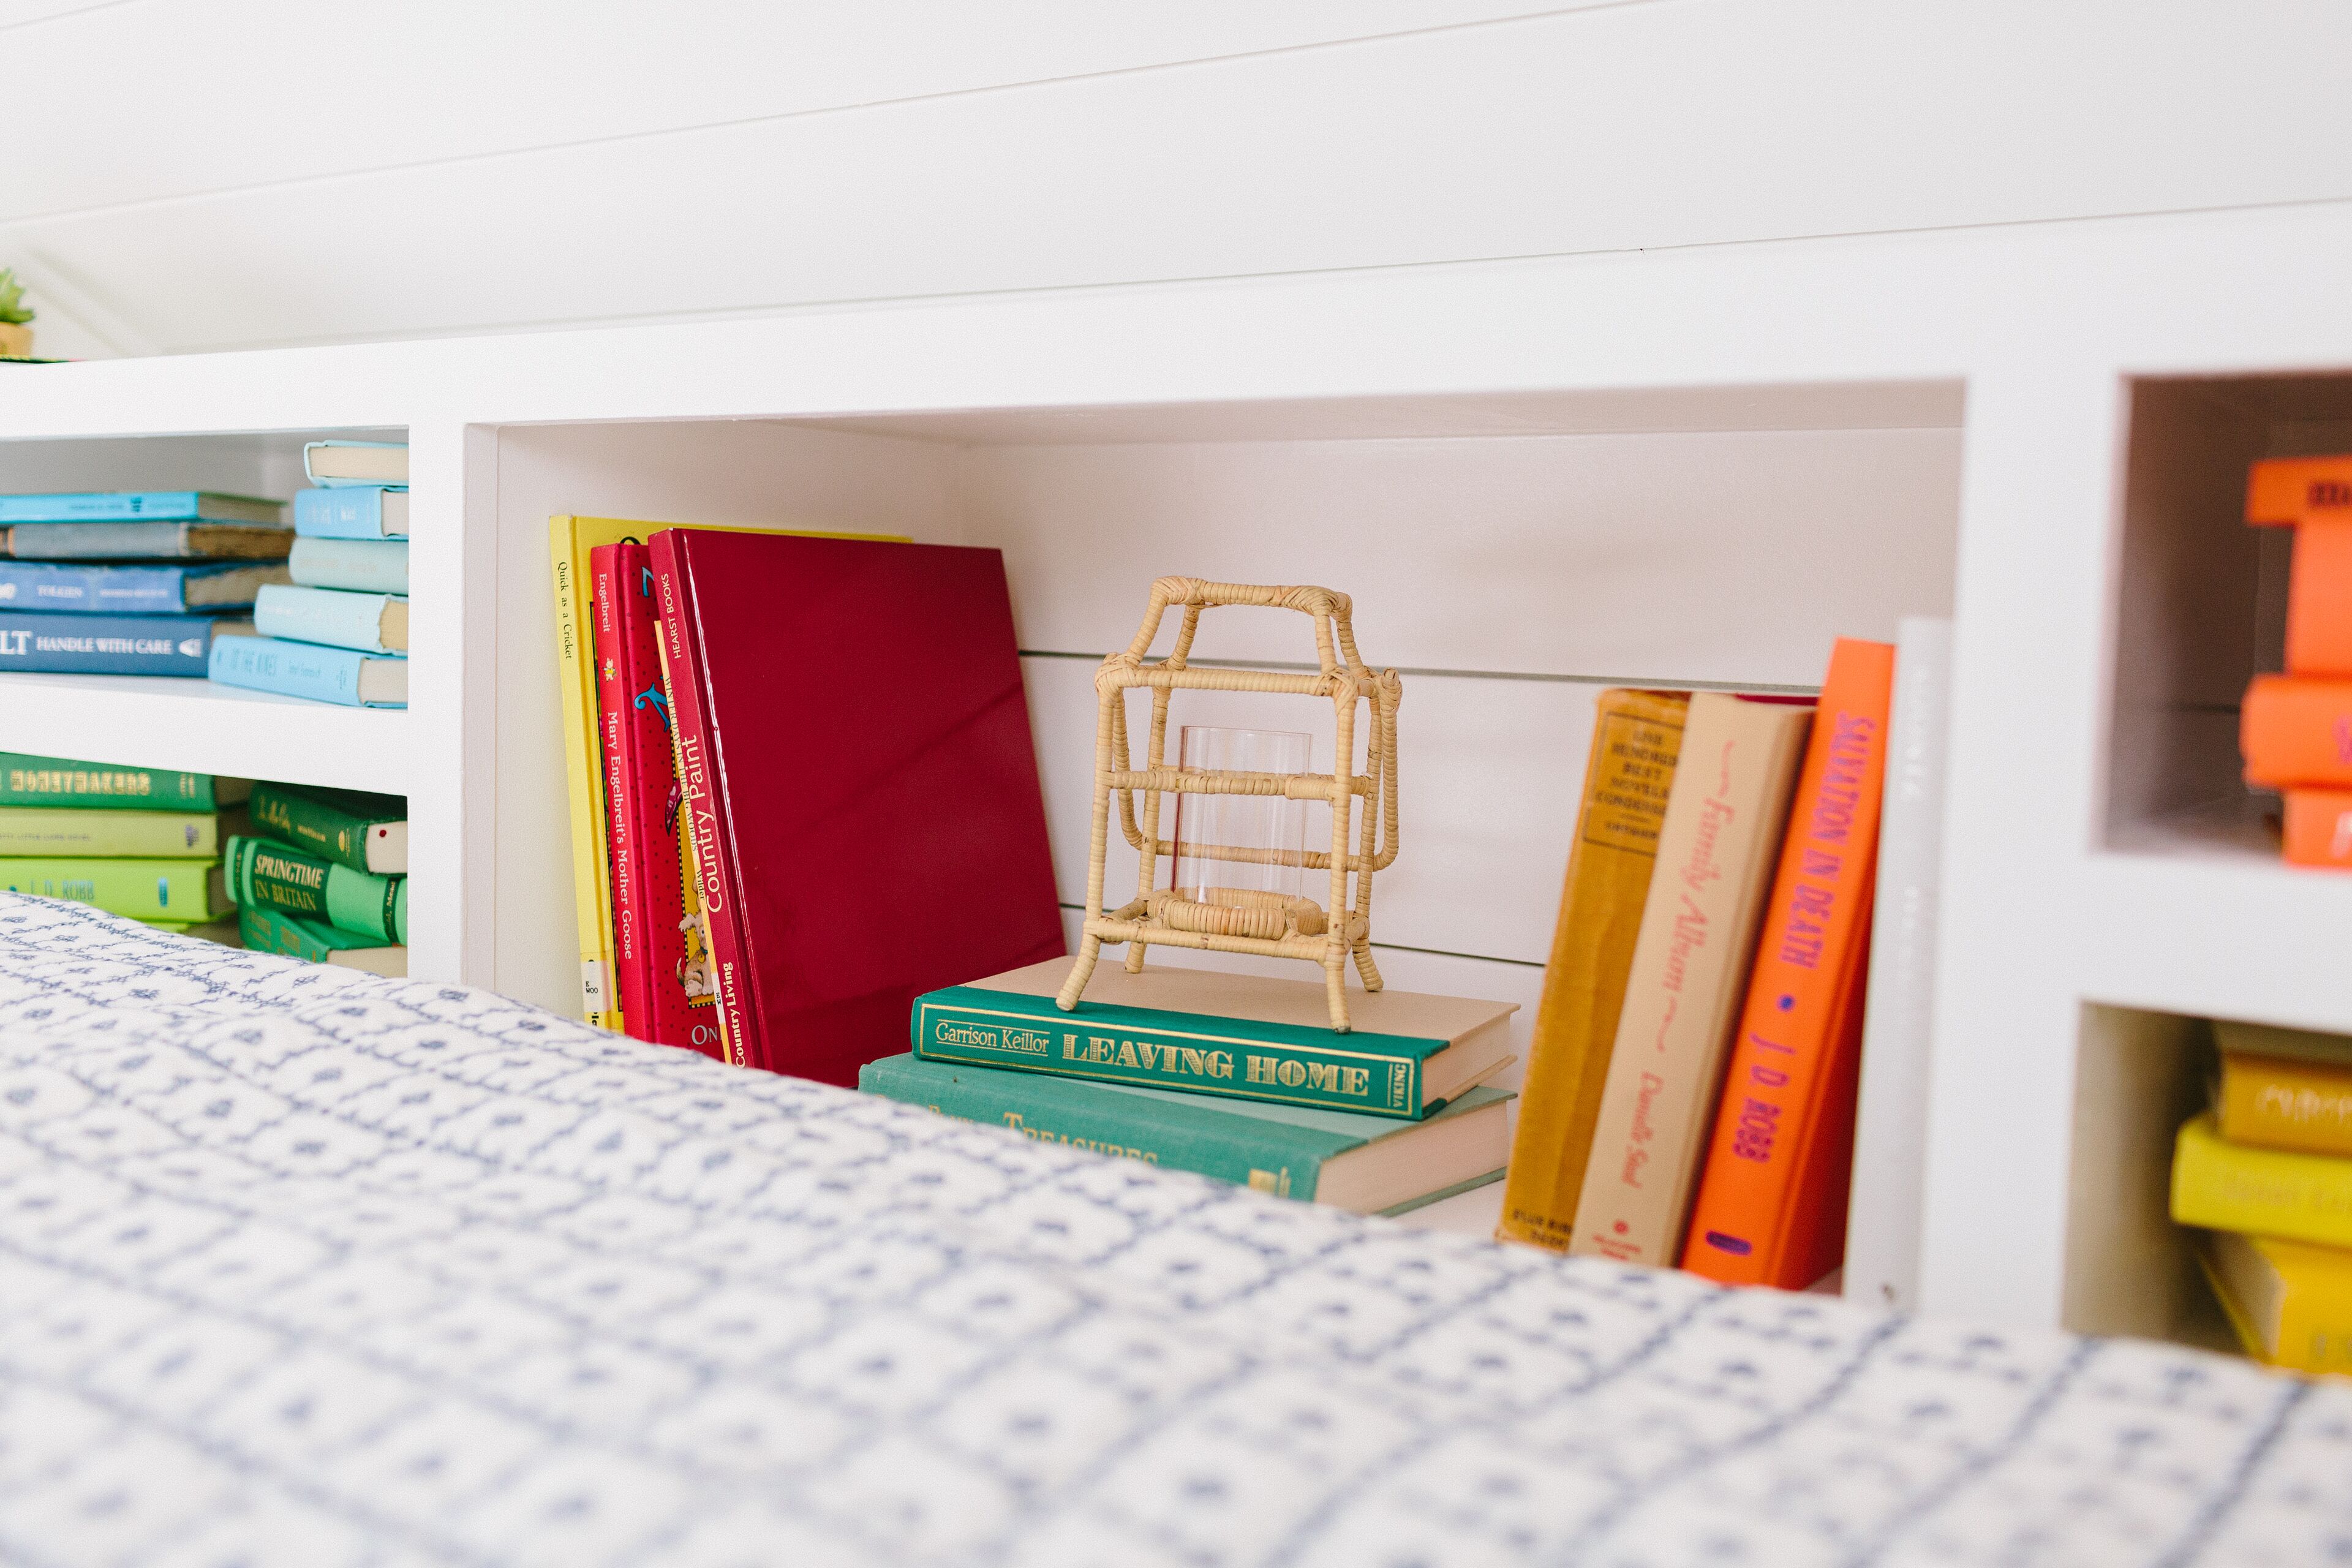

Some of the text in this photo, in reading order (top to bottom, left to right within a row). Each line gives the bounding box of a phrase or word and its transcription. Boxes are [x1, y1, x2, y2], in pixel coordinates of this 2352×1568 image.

[558, 562, 569, 592] Quick
[562, 597, 568, 607] as
[598, 573, 611, 632] Engelbreit
[661, 573, 682, 659] HEARST BOOKS
[36, 636, 94, 652] HANDLE
[96, 638, 134, 654] WITH
[135, 639, 173, 655] CARE
[564, 624, 573, 659] Cricket
[665, 677, 677, 719] WINTER
[672, 723, 681, 750] DAYS
[677, 752, 684, 763] IN
[687, 812, 697, 851] WOODS
[608, 712, 632, 959] Mary Engelbreit's Mother Goose
[682, 735, 723, 913] Country Paint
[1778, 710, 1877, 970] SALVATION IN DEATH
[62, 880, 94, 902] ROBB
[255, 854, 323, 889] SPRINGTIME
[696, 870, 705, 900] Wilder
[255, 880, 317, 911] IN BRITAIN
[692, 1025, 722, 1045] ON
[723, 962, 745, 1069] Country Living
[935, 1022, 1049, 1053] Garrison Keillor
[1062, 1033, 1370, 1096] LEAVING HOME
[1393, 1064, 1407, 1107] VIKING
[1732, 1030, 1797, 1164] J D ROBB
